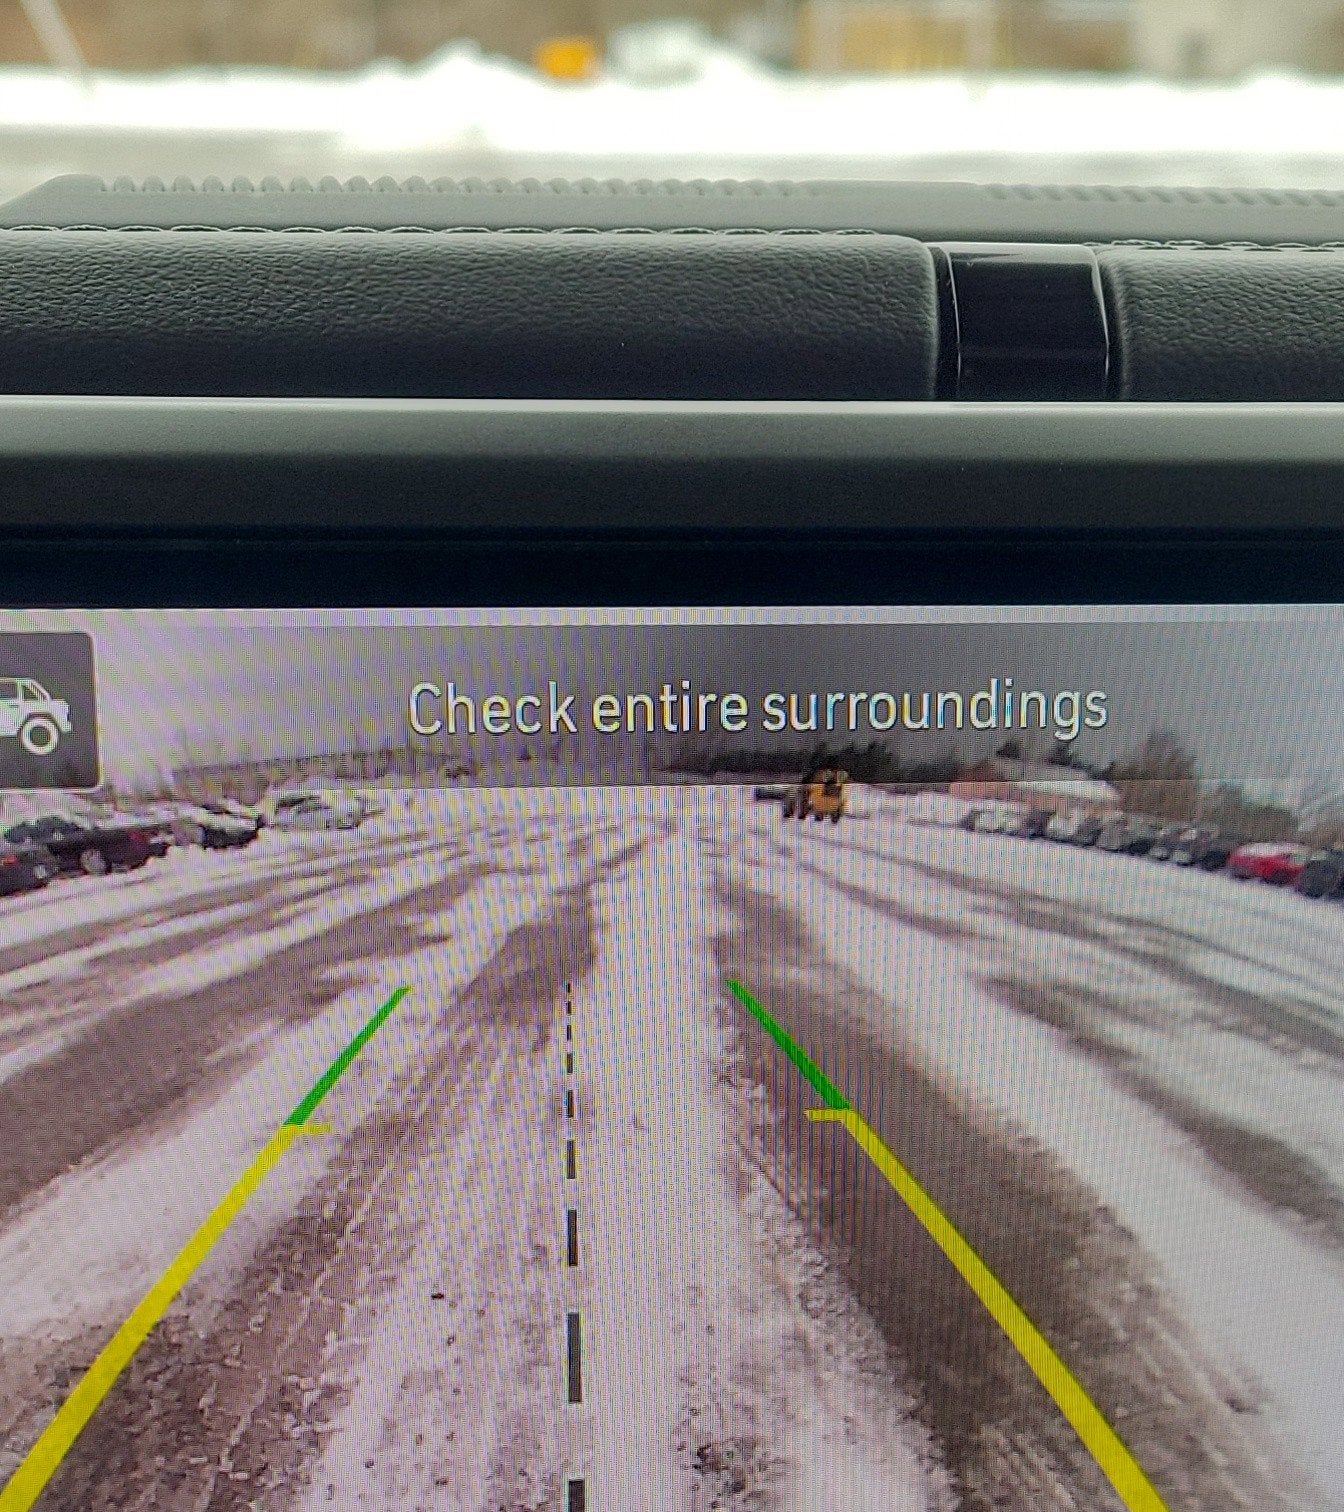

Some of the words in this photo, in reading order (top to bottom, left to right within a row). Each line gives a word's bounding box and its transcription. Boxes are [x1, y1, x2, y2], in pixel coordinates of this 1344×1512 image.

[409, 681, 578, 736] Check
[593, 680, 749, 734] entire
[763, 678, 1109, 740] surroundings
